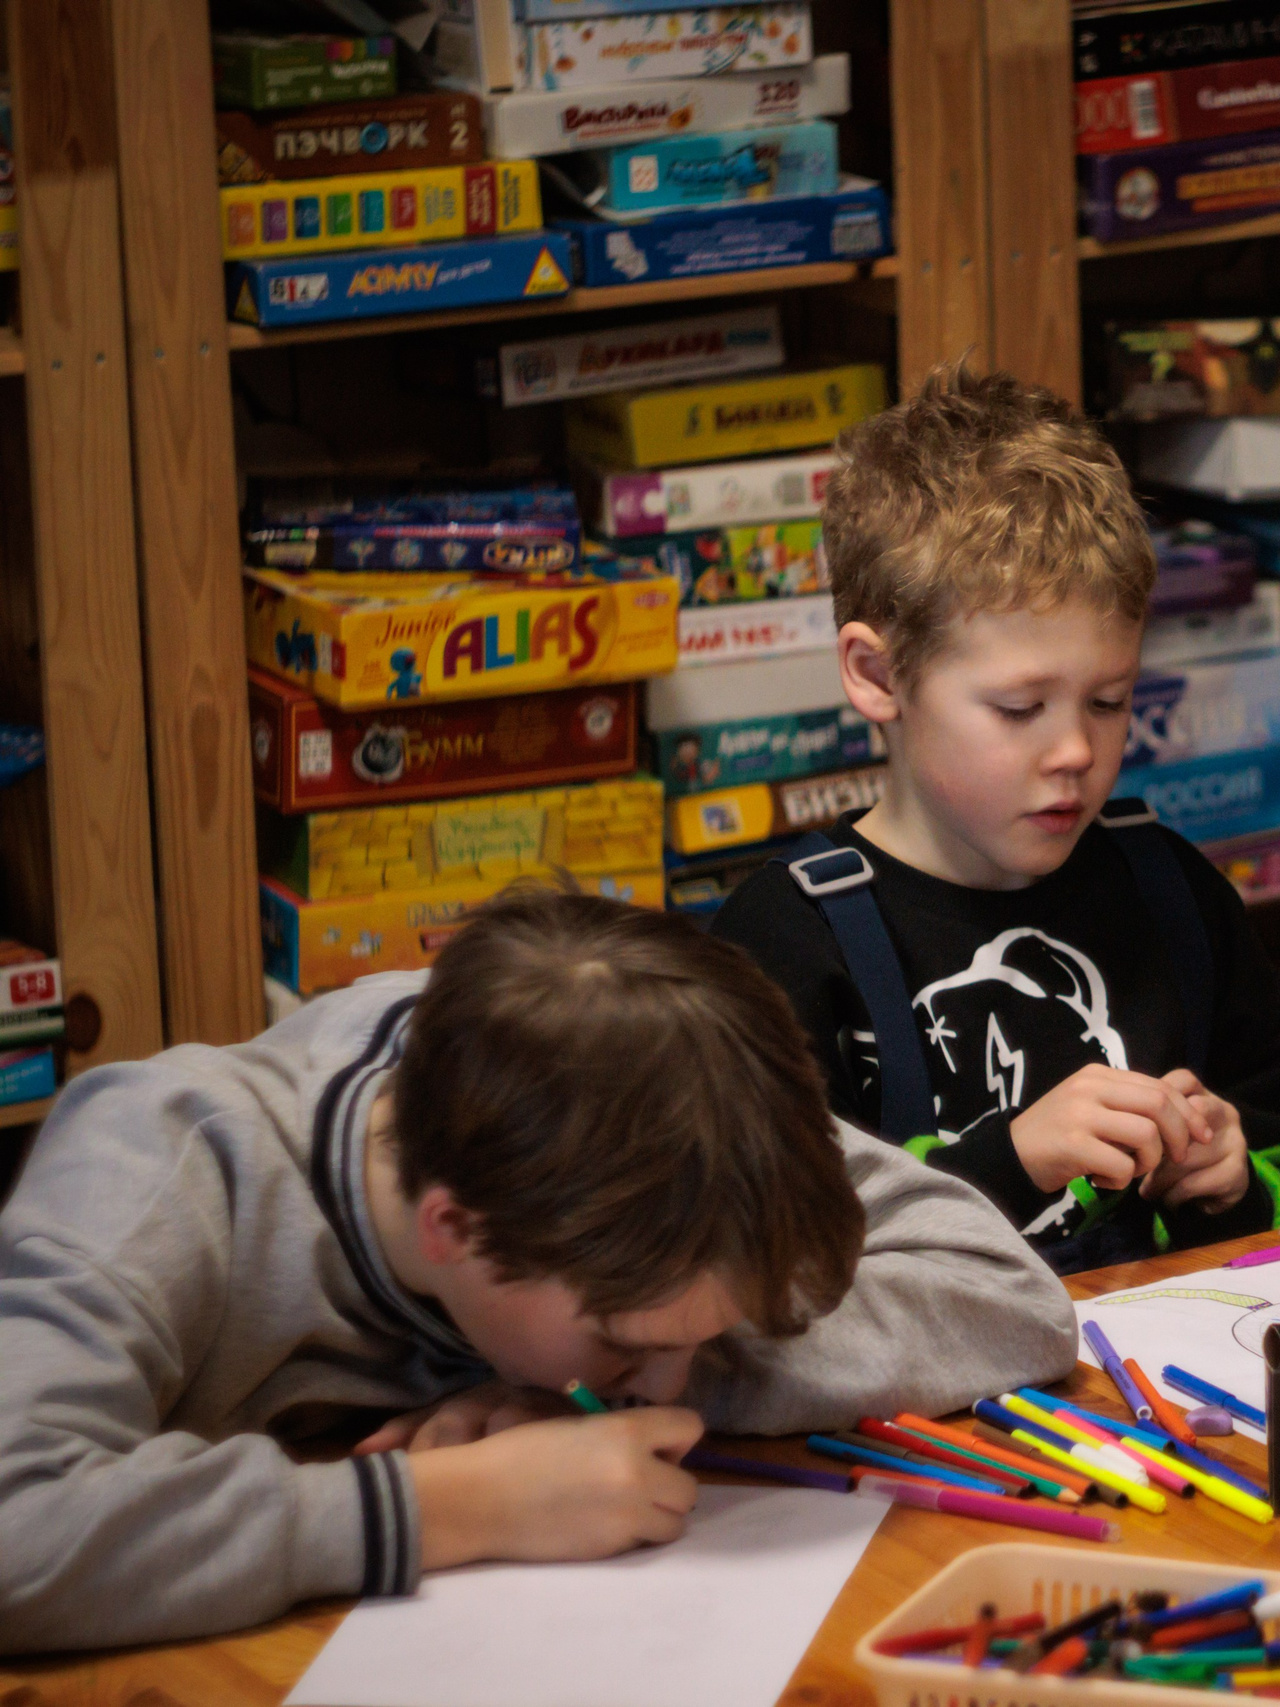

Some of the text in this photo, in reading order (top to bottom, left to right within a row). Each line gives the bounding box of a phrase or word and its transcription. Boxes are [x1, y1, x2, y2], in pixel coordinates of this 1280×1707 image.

[274, 121, 430, 161] ПЭЧВОРК
[375, 609, 457, 646] Junior
[442, 596, 601, 680] ALIAS
